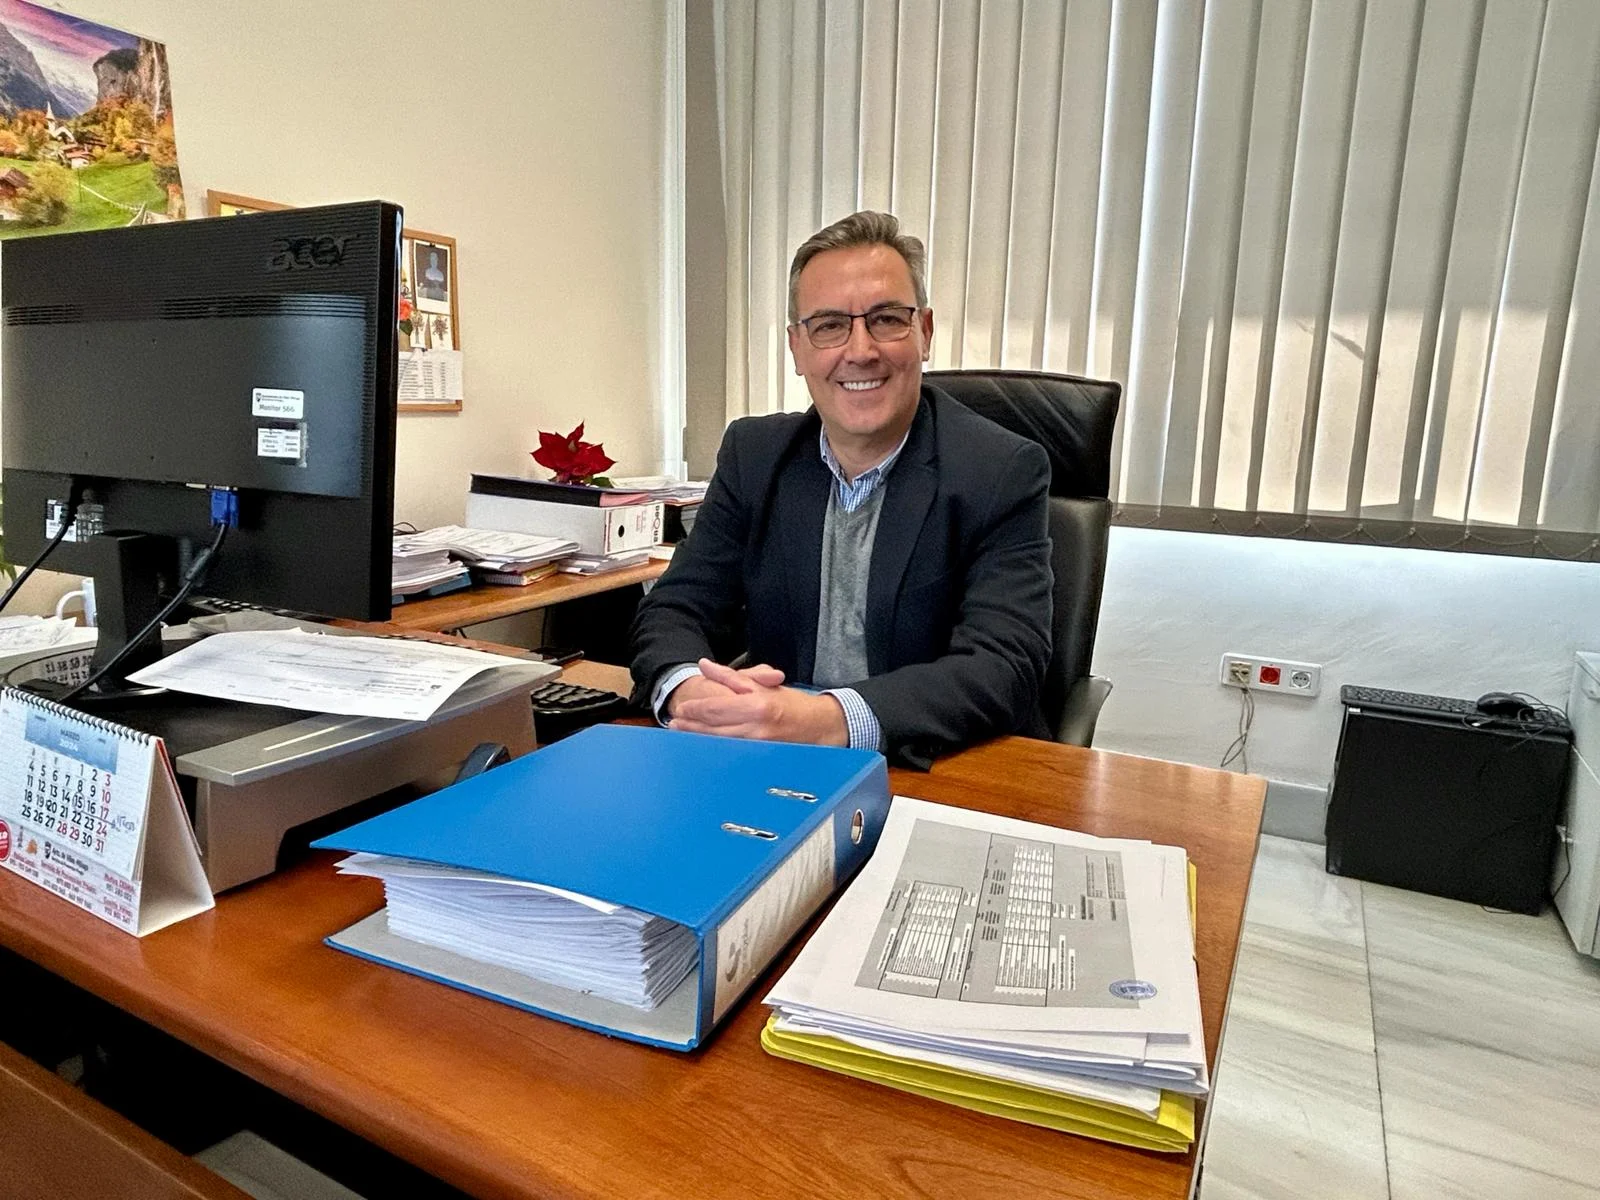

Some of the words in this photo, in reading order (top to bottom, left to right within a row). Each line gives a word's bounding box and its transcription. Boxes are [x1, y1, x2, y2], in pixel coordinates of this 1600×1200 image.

[27, 775, 33, 787] 11
[39, 779, 45, 792] 12
[50, 784, 57, 798] 13
[62, 789, 70, 803] 14
[74, 795, 82, 808] 15
[88, 800, 96, 814] 16
[101, 806, 109, 820] 17
[29, 760, 34, 772] 4
[41, 765, 46, 776] 5
[52, 770, 58, 781] 6
[65, 775, 70, 786] 7
[78, 780, 83, 792] 8
[90, 785, 96, 797] 9
[102, 790, 111, 803] 10
[80, 764, 84, 776] 1
[92, 769, 98, 781] 2
[105, 774, 111, 786] 3
[22, 805, 31, 818] 25
[34, 810, 43, 824] 26
[45, 815, 55, 829] 27
[57, 821, 67, 835] 28
[69, 827, 79, 840] 29
[81, 832, 92, 847] 30
[96, 839, 104, 853] 31
[25, 789, 32, 802] 18
[37, 795, 44, 808] 19
[47, 800, 57, 813] 20
[60, 806, 68, 819] 21
[72, 811, 81, 825] 22
[85, 817, 94, 831] 23
[96, 822, 107, 837] 24
